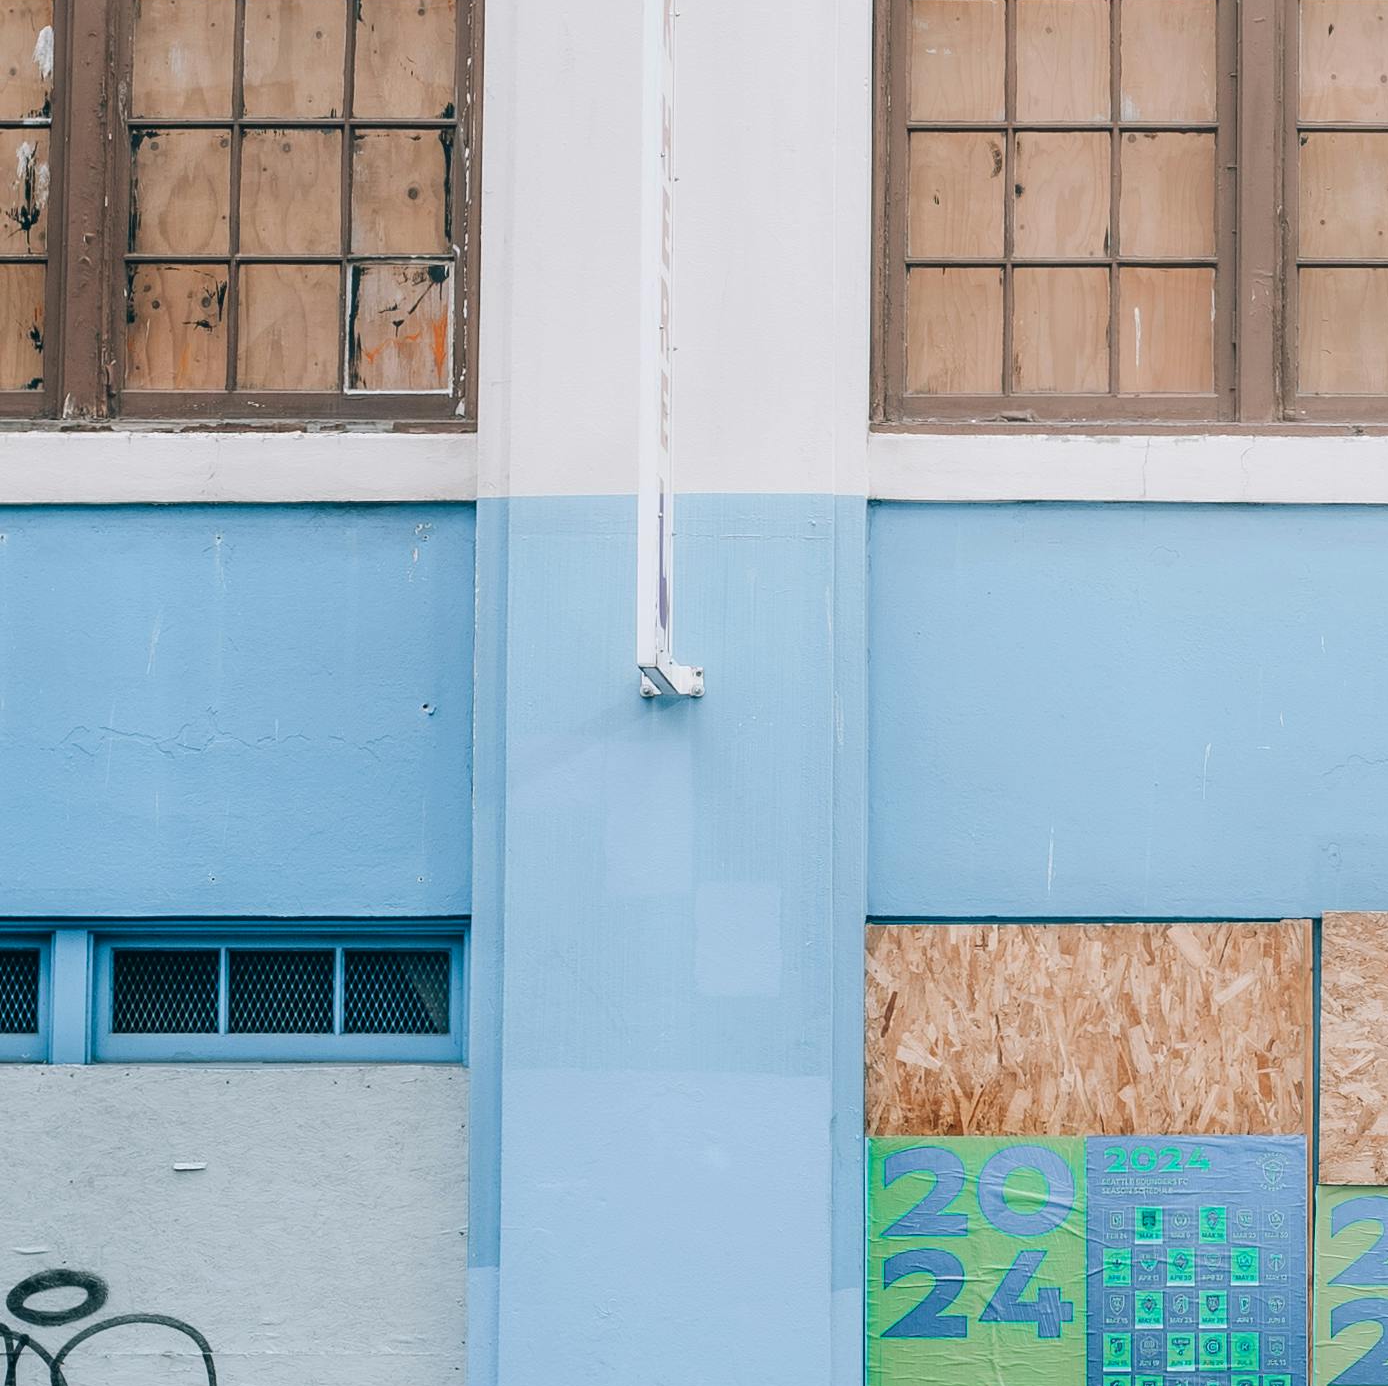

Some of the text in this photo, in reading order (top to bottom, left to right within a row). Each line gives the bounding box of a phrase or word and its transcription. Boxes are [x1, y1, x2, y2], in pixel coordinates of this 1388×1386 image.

[880, 1144, 1075, 1238] 20
[1103, 1146, 1212, 1173] 2024
[880, 1247, 1075, 1339] 24
